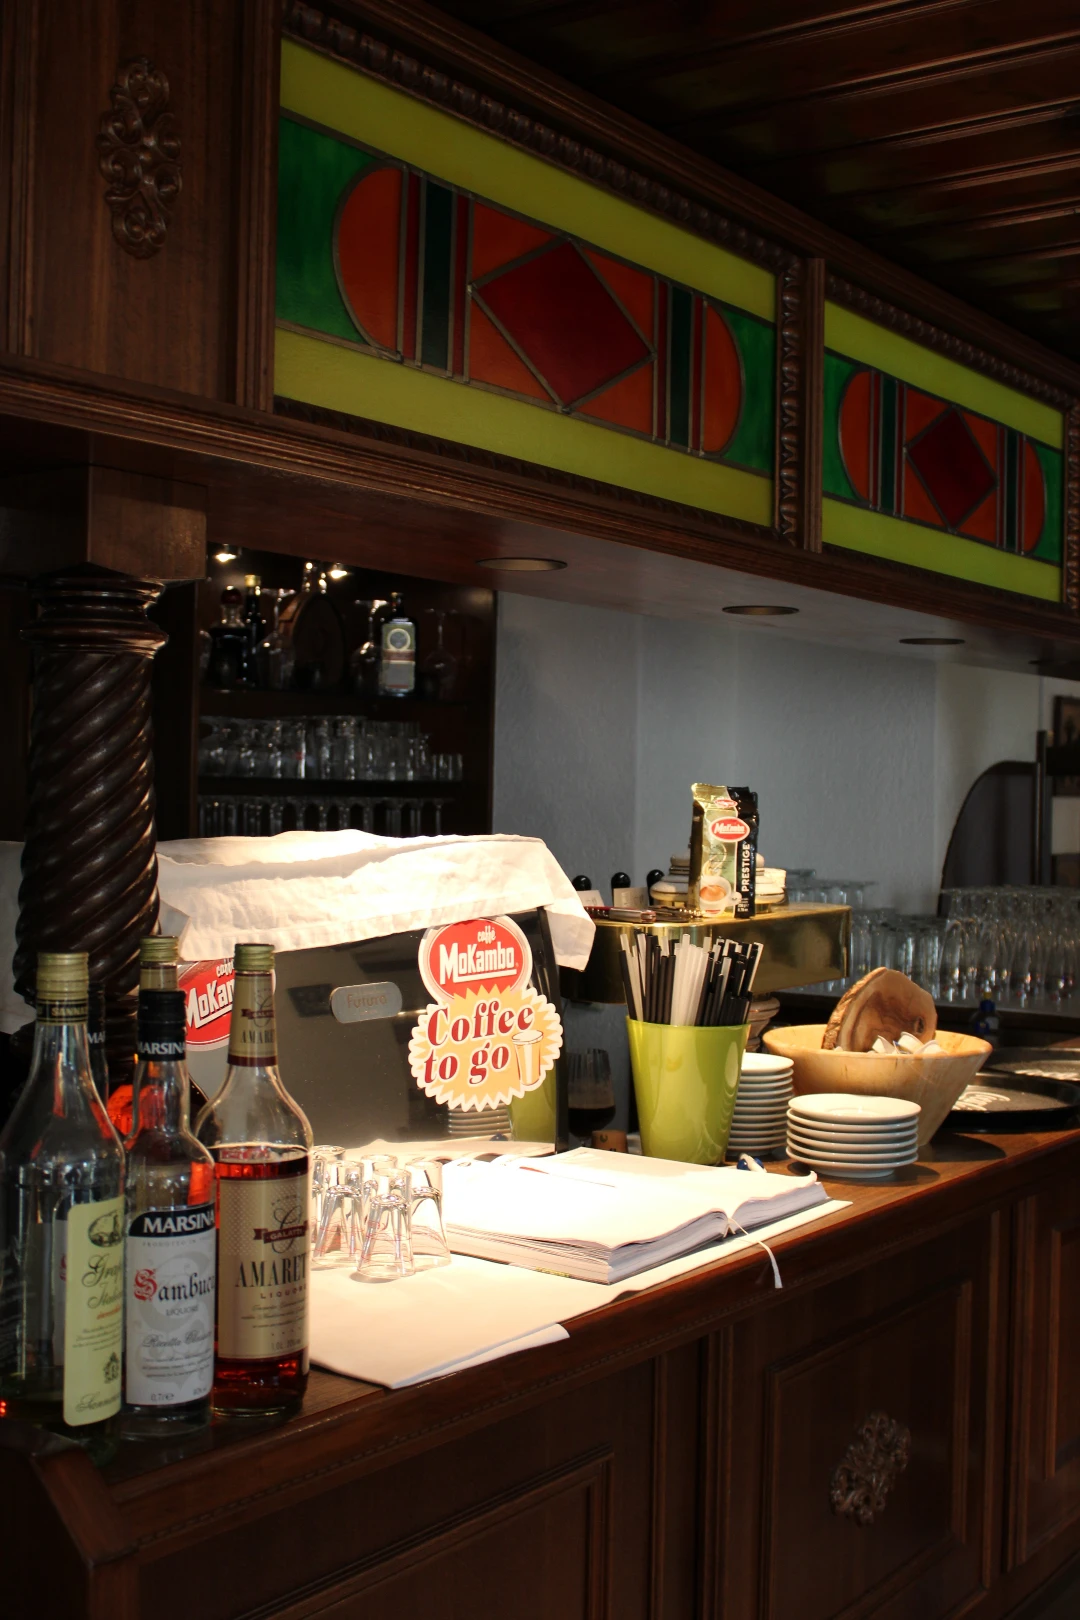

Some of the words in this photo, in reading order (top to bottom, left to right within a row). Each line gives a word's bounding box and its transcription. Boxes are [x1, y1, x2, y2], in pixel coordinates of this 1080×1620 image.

[741, 843, 750, 892] PRESTIGE
[439, 941, 516, 985] MoKambo
[427, 1000, 534, 1047] Coffee
[424, 1050, 458, 1084] to
[469, 1042, 509, 1085] go
